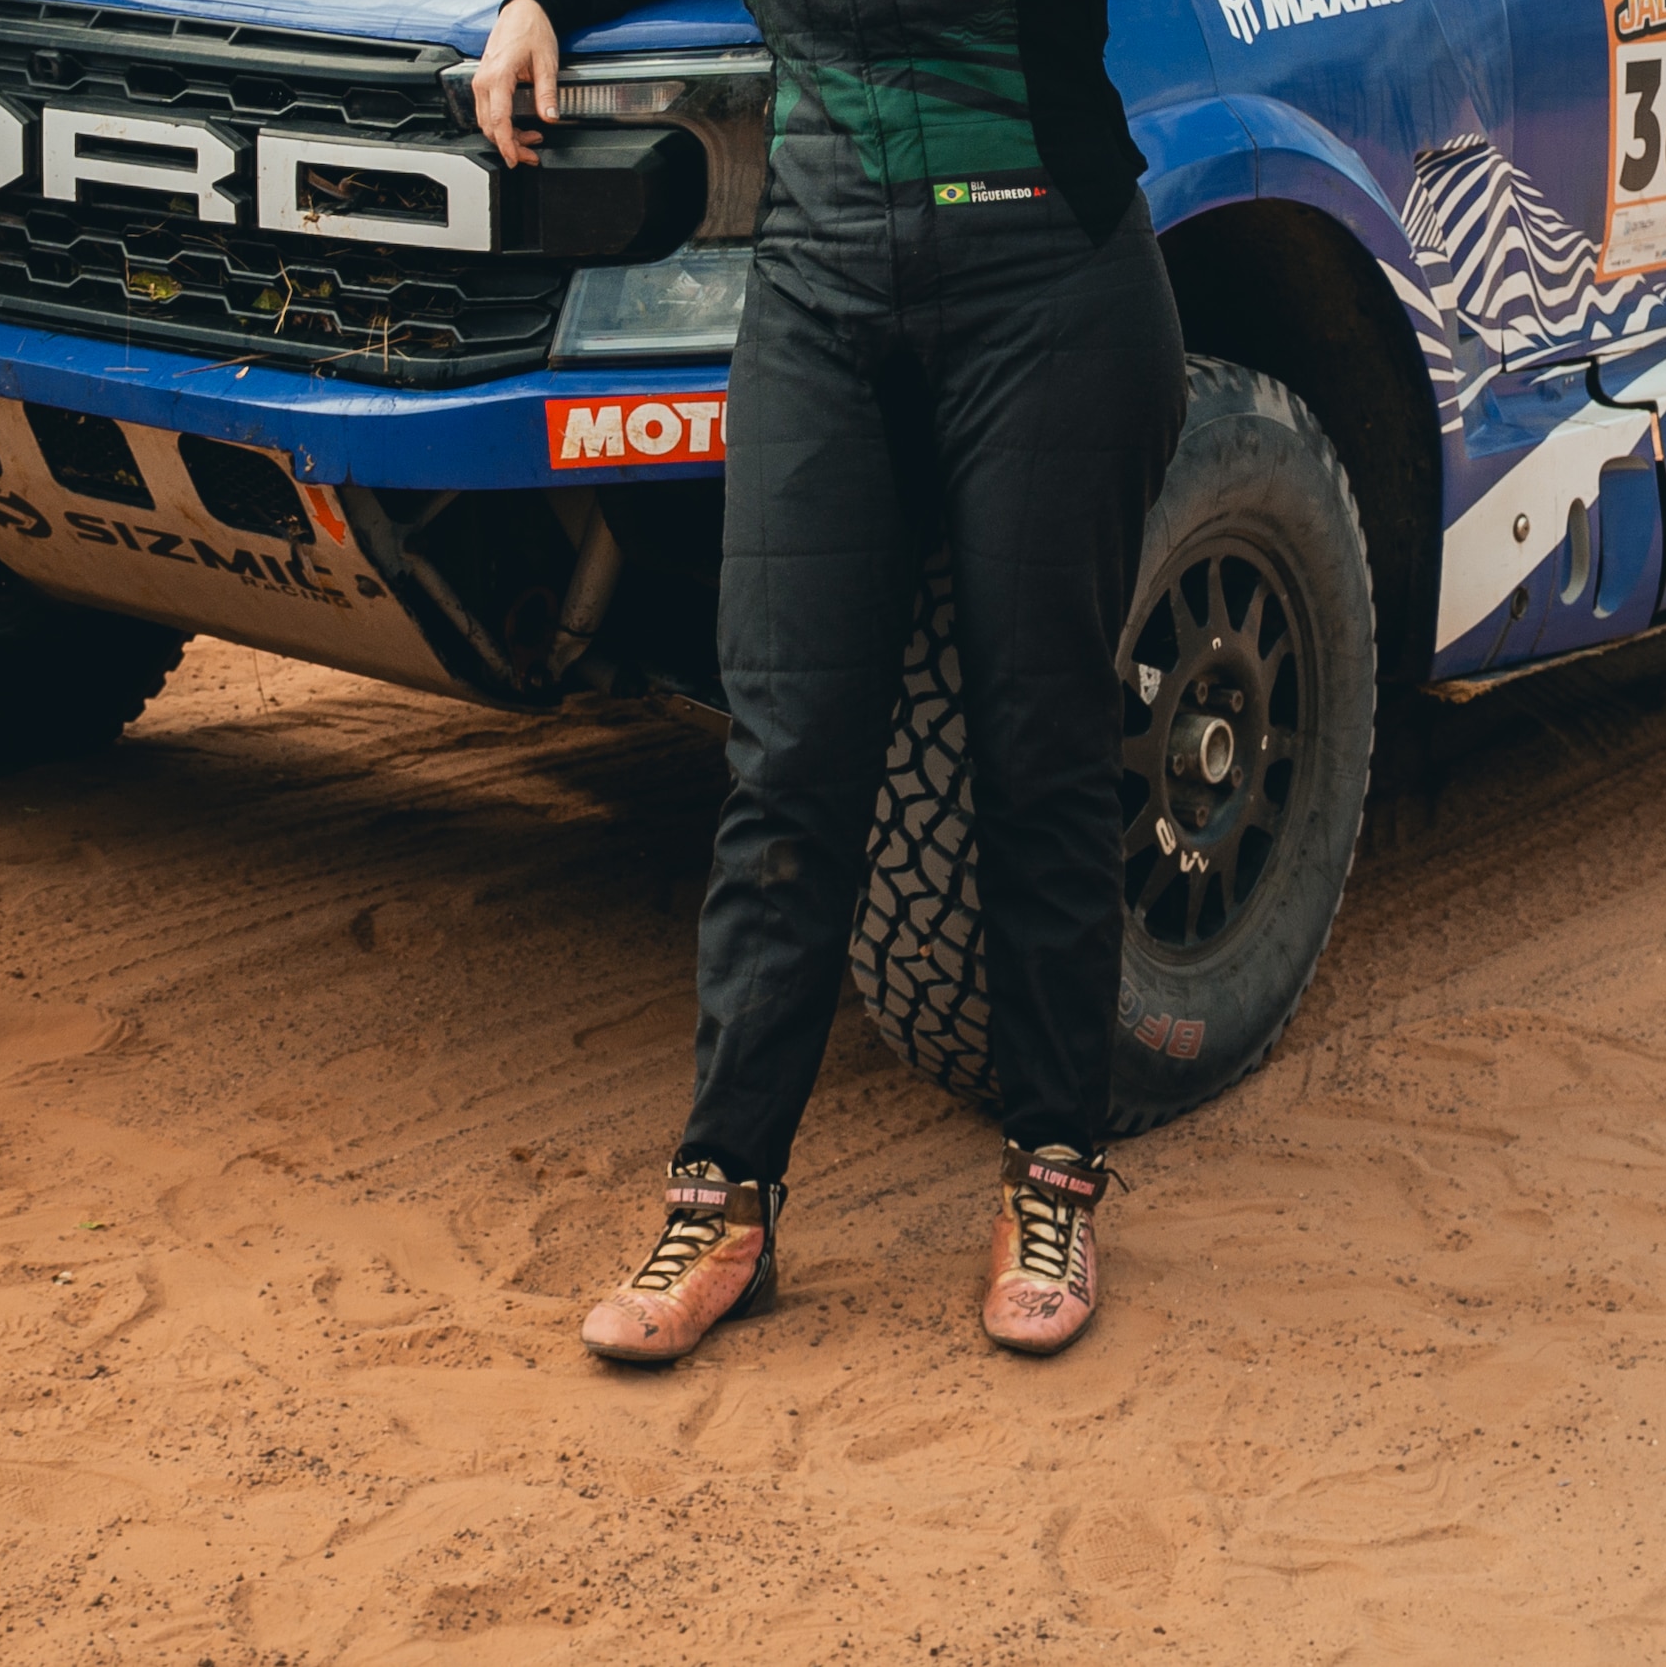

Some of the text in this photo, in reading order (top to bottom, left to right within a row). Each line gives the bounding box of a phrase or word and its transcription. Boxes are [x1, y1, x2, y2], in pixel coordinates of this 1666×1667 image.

[970, 181, 986, 192] BIA
[971, 187, 1032, 203] FIGUEIREDO
[560, 401, 727, 459] MOT
[64, 511, 345, 597] SIZMIC
[240, 575, 353, 609] RACING
[1029, 1164, 1043, 1180] WE
[1044, 1169, 1069, 1188] LOVE
[697, 1189, 727, 1205] TRUST
